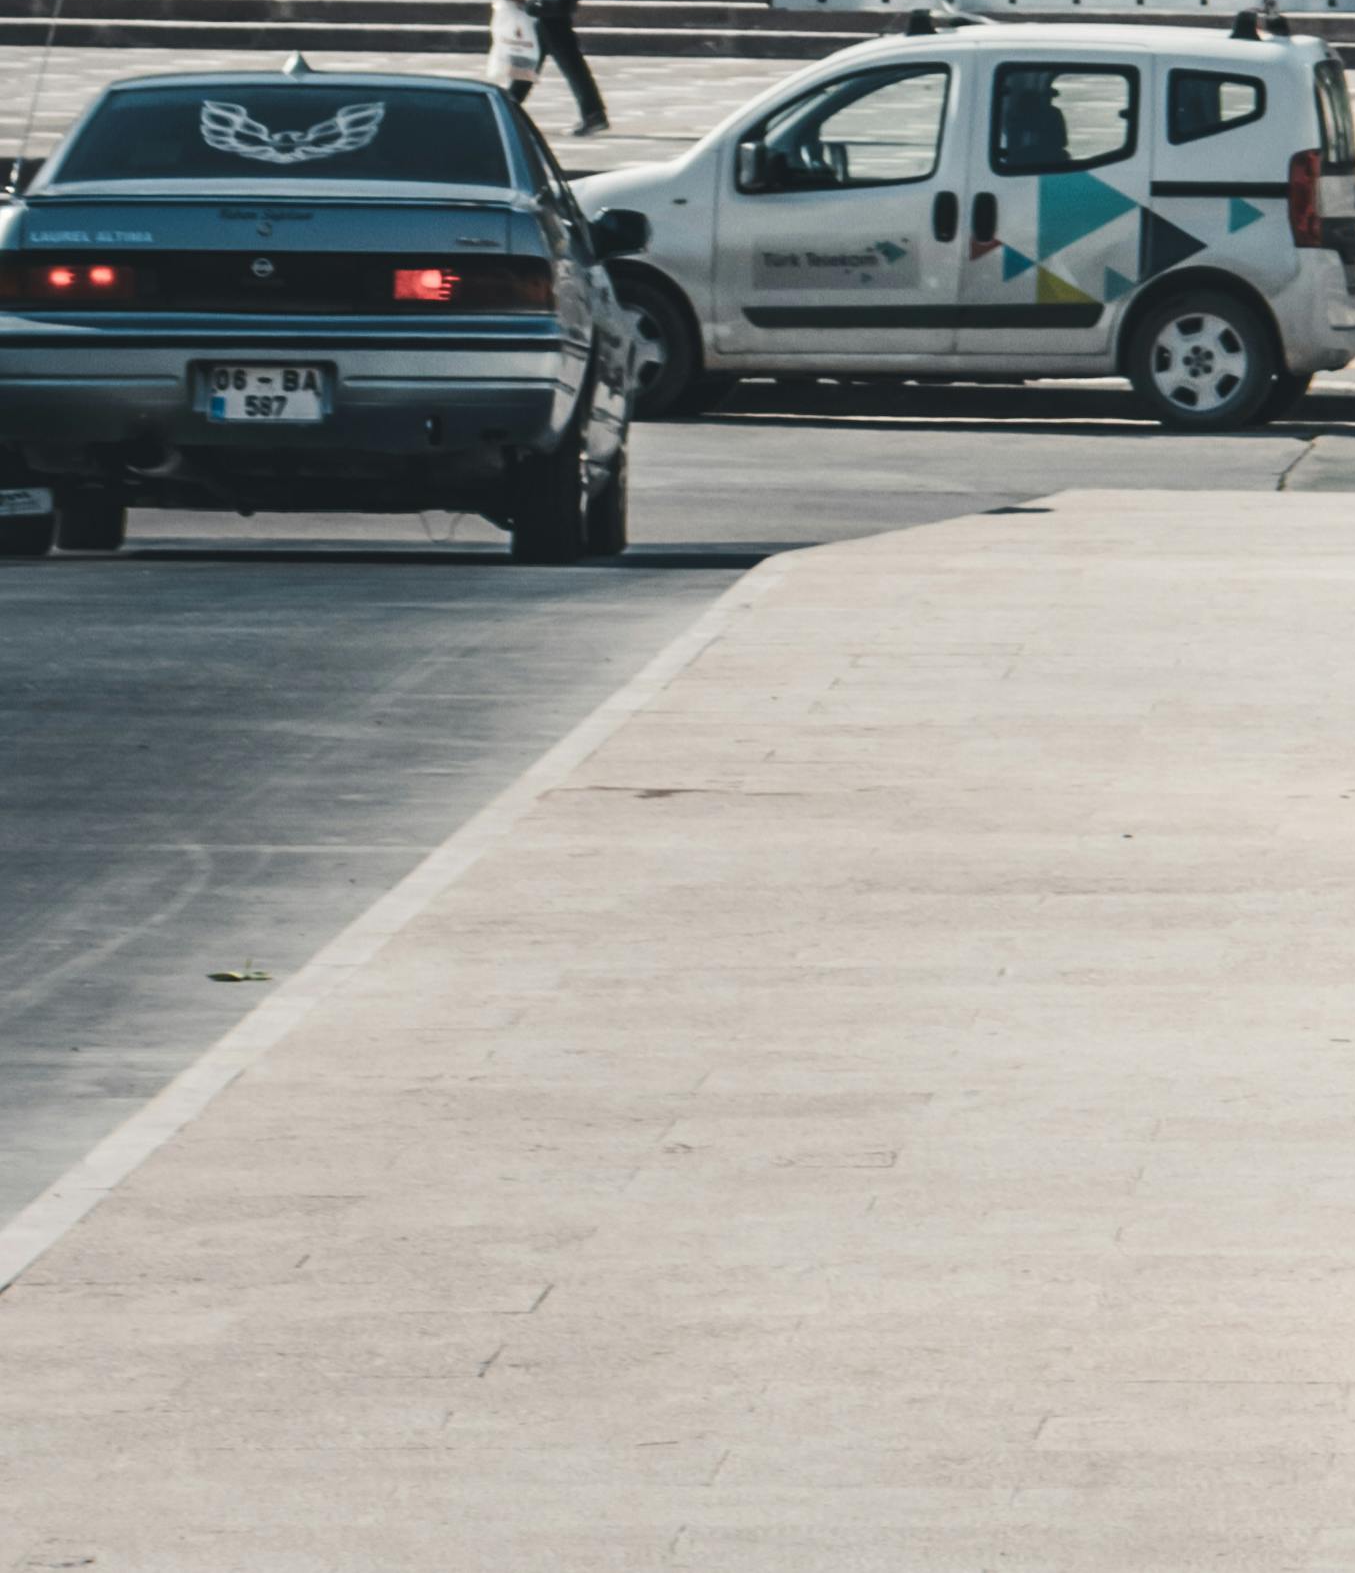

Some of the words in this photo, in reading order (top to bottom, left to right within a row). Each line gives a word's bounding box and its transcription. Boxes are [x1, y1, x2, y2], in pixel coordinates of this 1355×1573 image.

[30, 230, 91, 242] LAUREL
[96, 230, 154, 242] ALTIMA
[805, 251, 879, 268] Telekom
[214, 368, 248, 391] 06
[281, 368, 318, 392] BA
